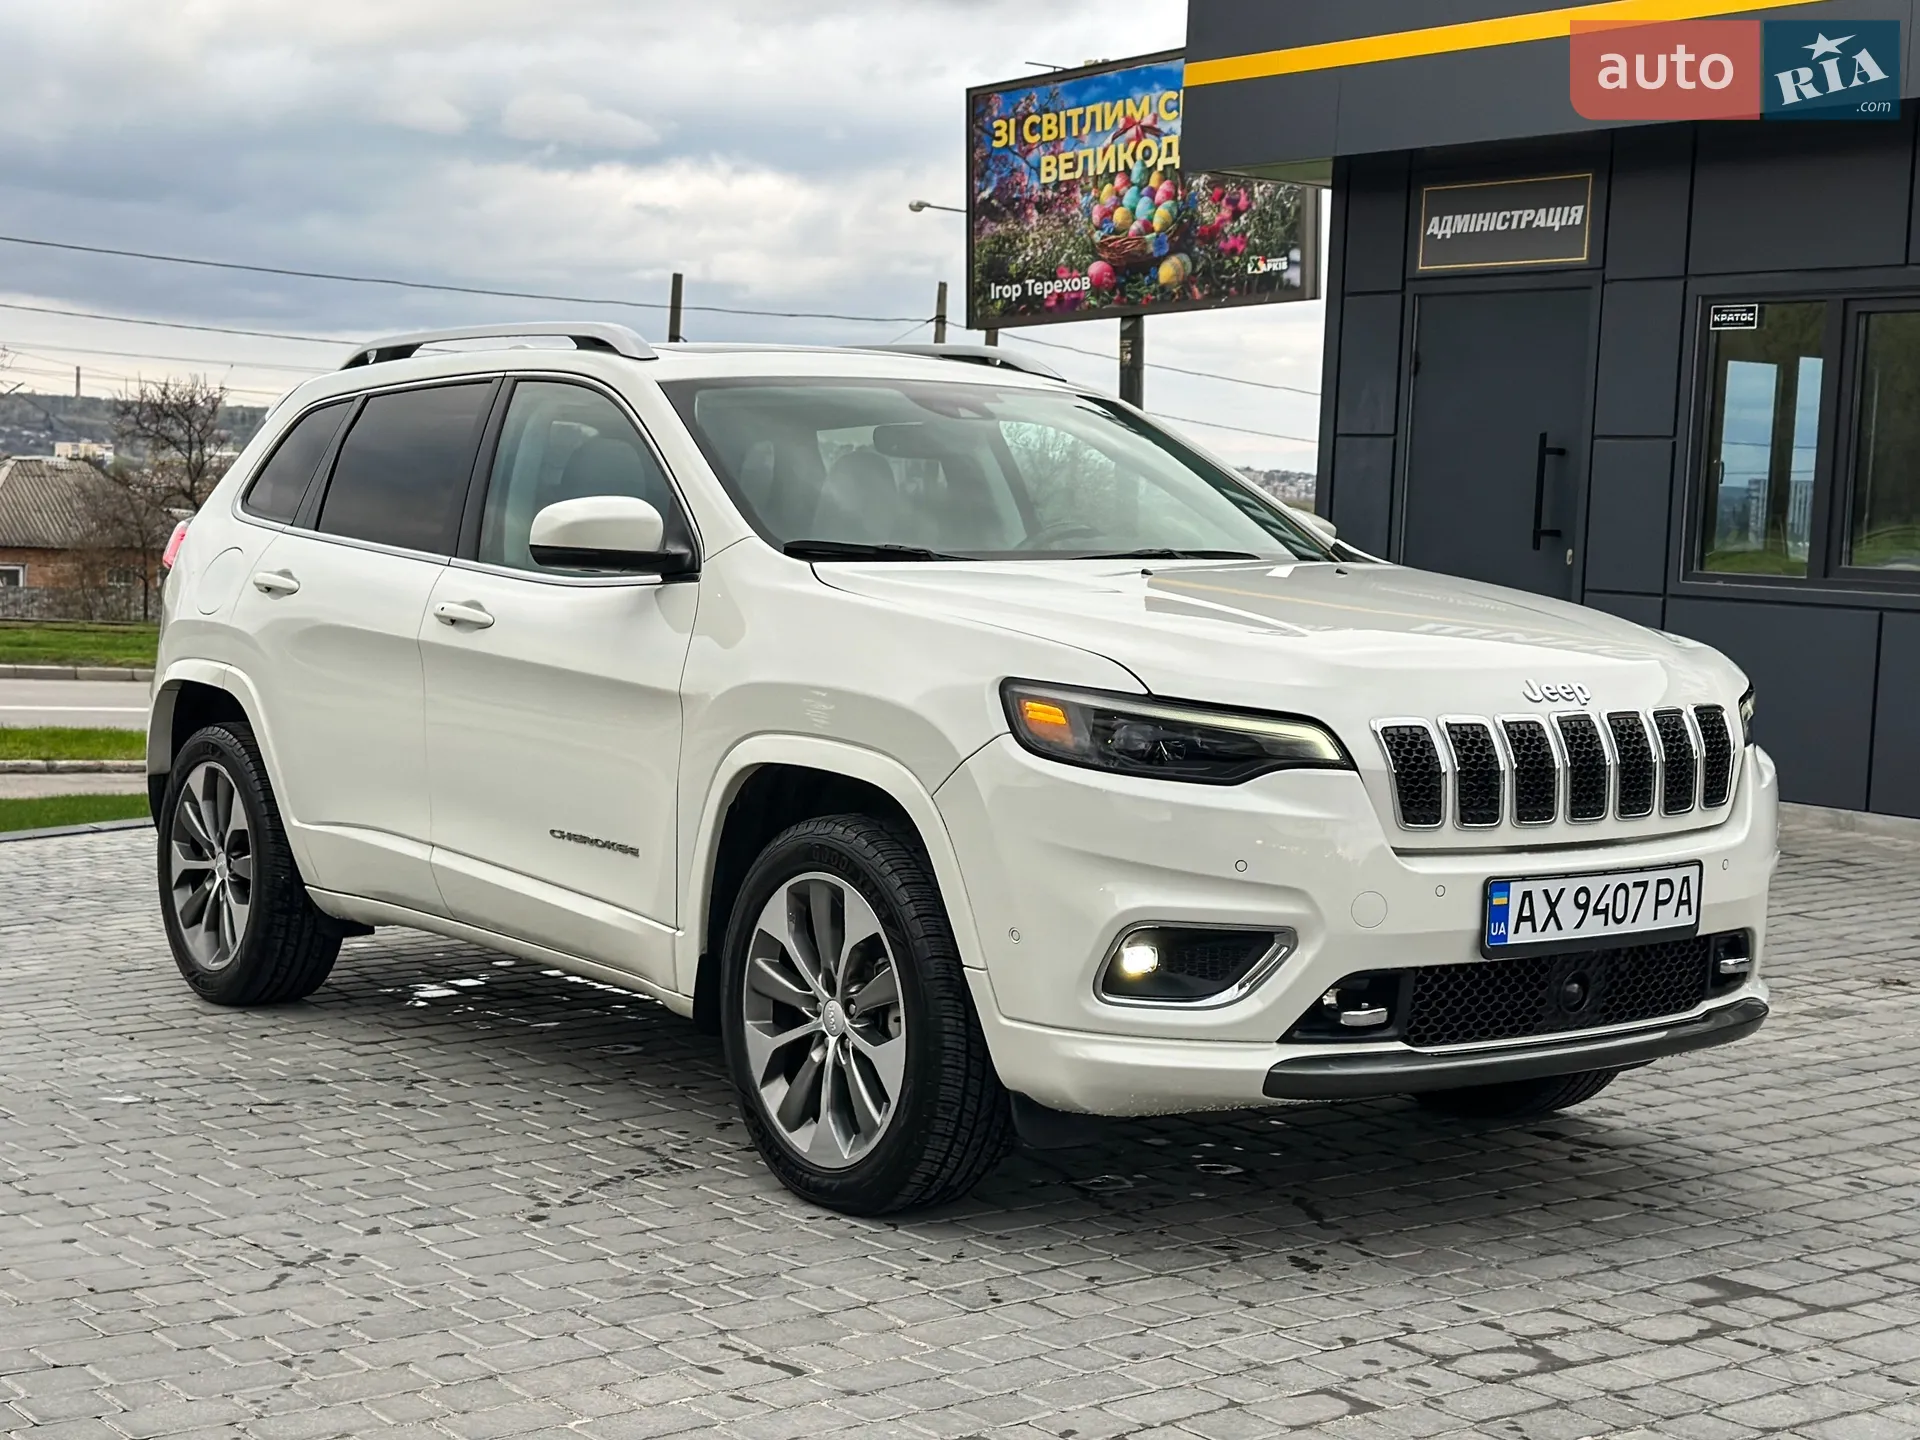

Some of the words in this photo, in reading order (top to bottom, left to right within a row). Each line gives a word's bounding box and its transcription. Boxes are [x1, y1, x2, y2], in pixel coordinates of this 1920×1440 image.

[991, 118, 1016, 148] ЗІ
[1022, 95, 1150, 145] СВІТЛИМ
[1158, 89, 1183, 121] С
[1426, 204, 1585, 240] АДМІНІСТРАЦІЯ
[990, 282, 1022, 302] Ігор
[1025, 276, 1092, 299] Терехов
[1713, 312, 1755, 322] КРАТОС
[1522, 678, 1592, 706] Jeep
[1513, 886, 1566, 935] AX
[1573, 879, 1650, 930] 9407
[1652, 875, 1693, 922] PA
[1490, 922, 1507, 937] UA
